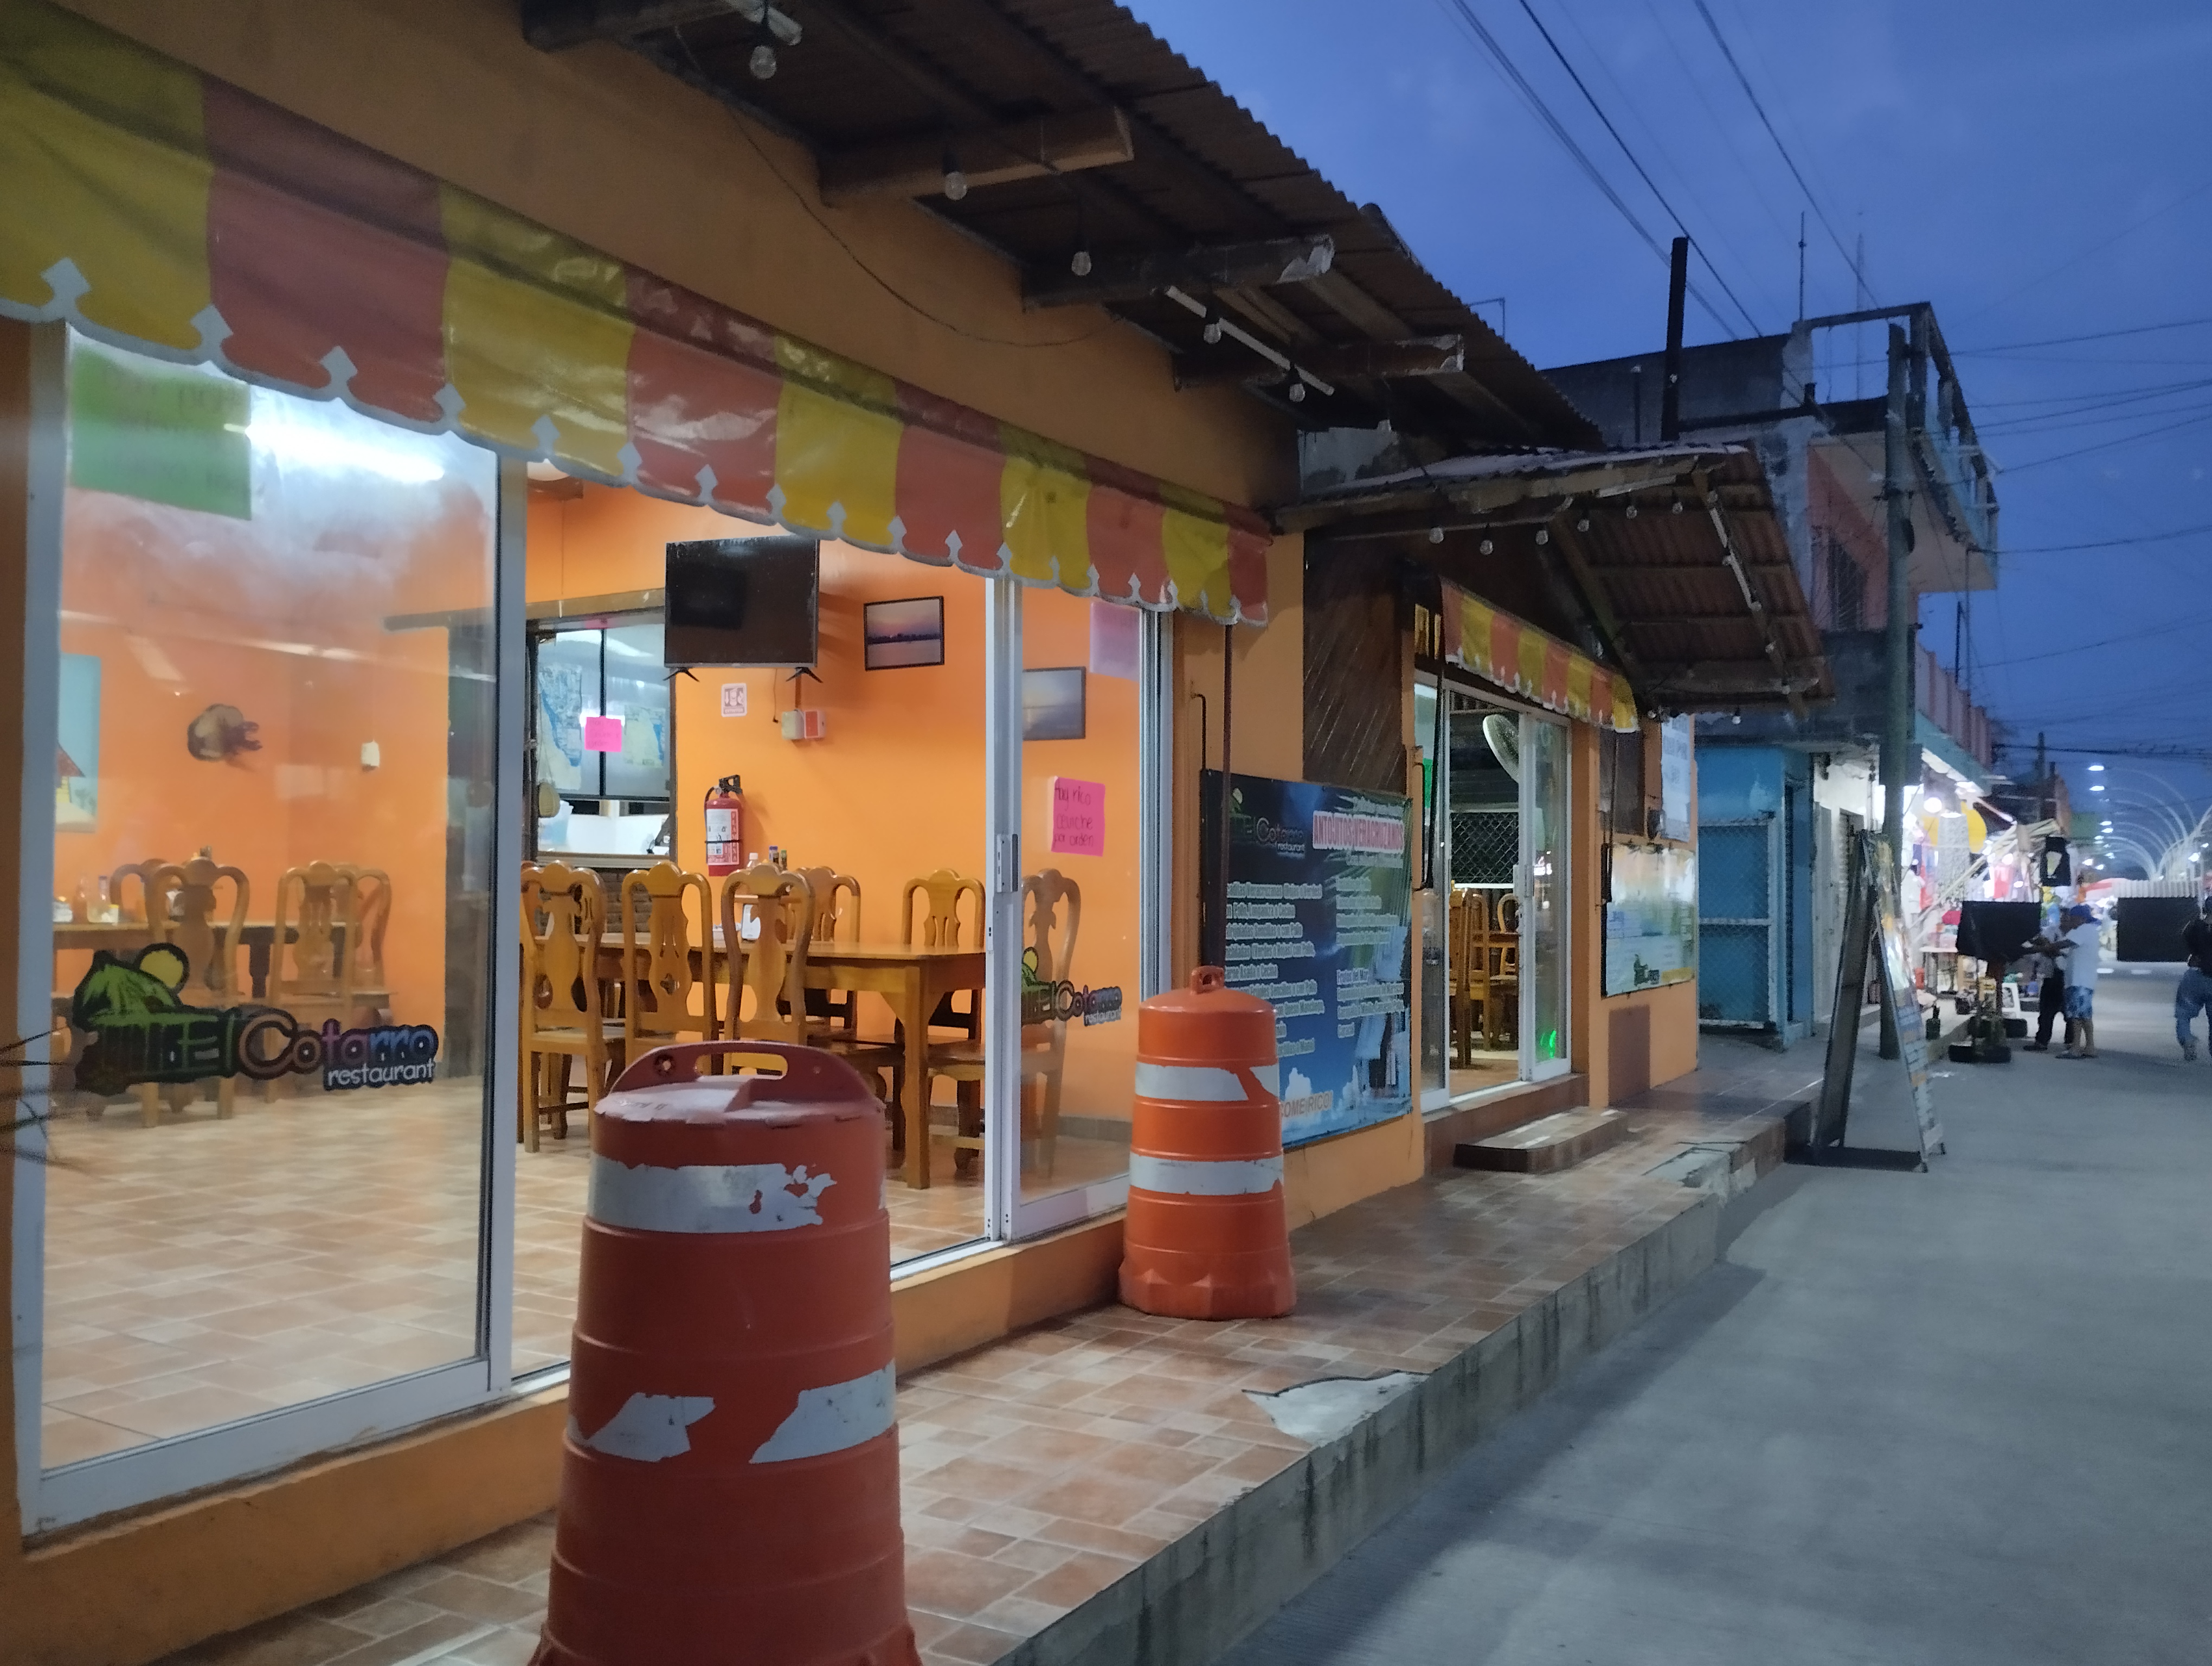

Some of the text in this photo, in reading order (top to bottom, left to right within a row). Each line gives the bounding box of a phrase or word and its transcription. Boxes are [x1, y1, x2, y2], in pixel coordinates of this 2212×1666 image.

[1073, 786, 1091, 805] rico
[1070, 833, 1094, 847] orden
[1314, 814, 1403, 850] ANTOJITOS VERACRUZANOS
[1277, 841, 1305, 852] restaurant
[1085, 1007, 1122, 1024] restaurant
[239, 1012, 436, 1078] Cotarro
[327, 1061, 435, 1087] restaurant
